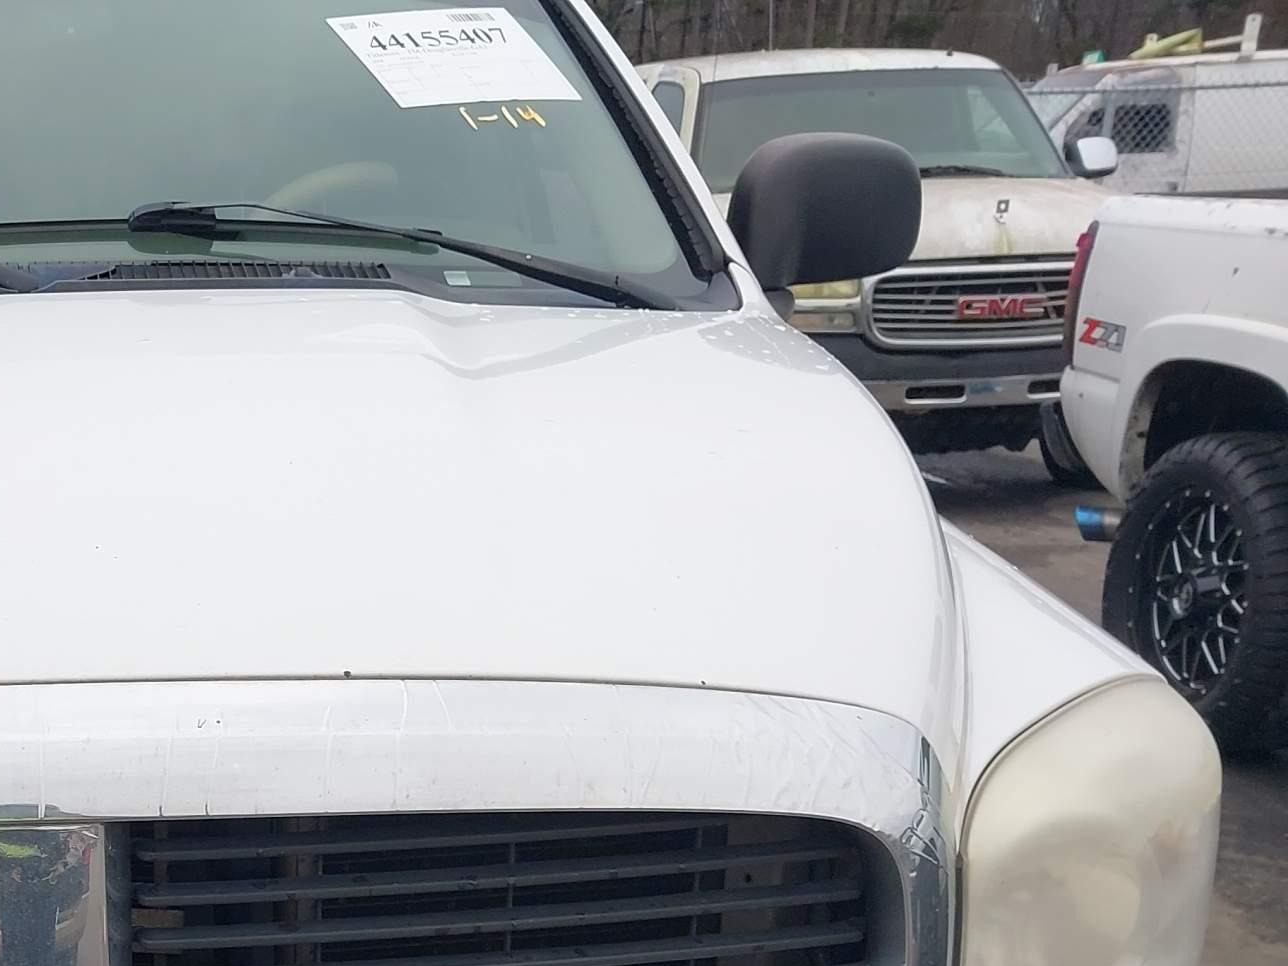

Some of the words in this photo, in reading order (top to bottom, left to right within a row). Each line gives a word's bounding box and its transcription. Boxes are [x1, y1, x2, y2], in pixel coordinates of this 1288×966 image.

[369, 27, 508, 51] 44155407
[458, 105, 547, 131] 1-14
[958, 295, 1046, 319] GMC
[1078, 316, 1128, 353] Z71
